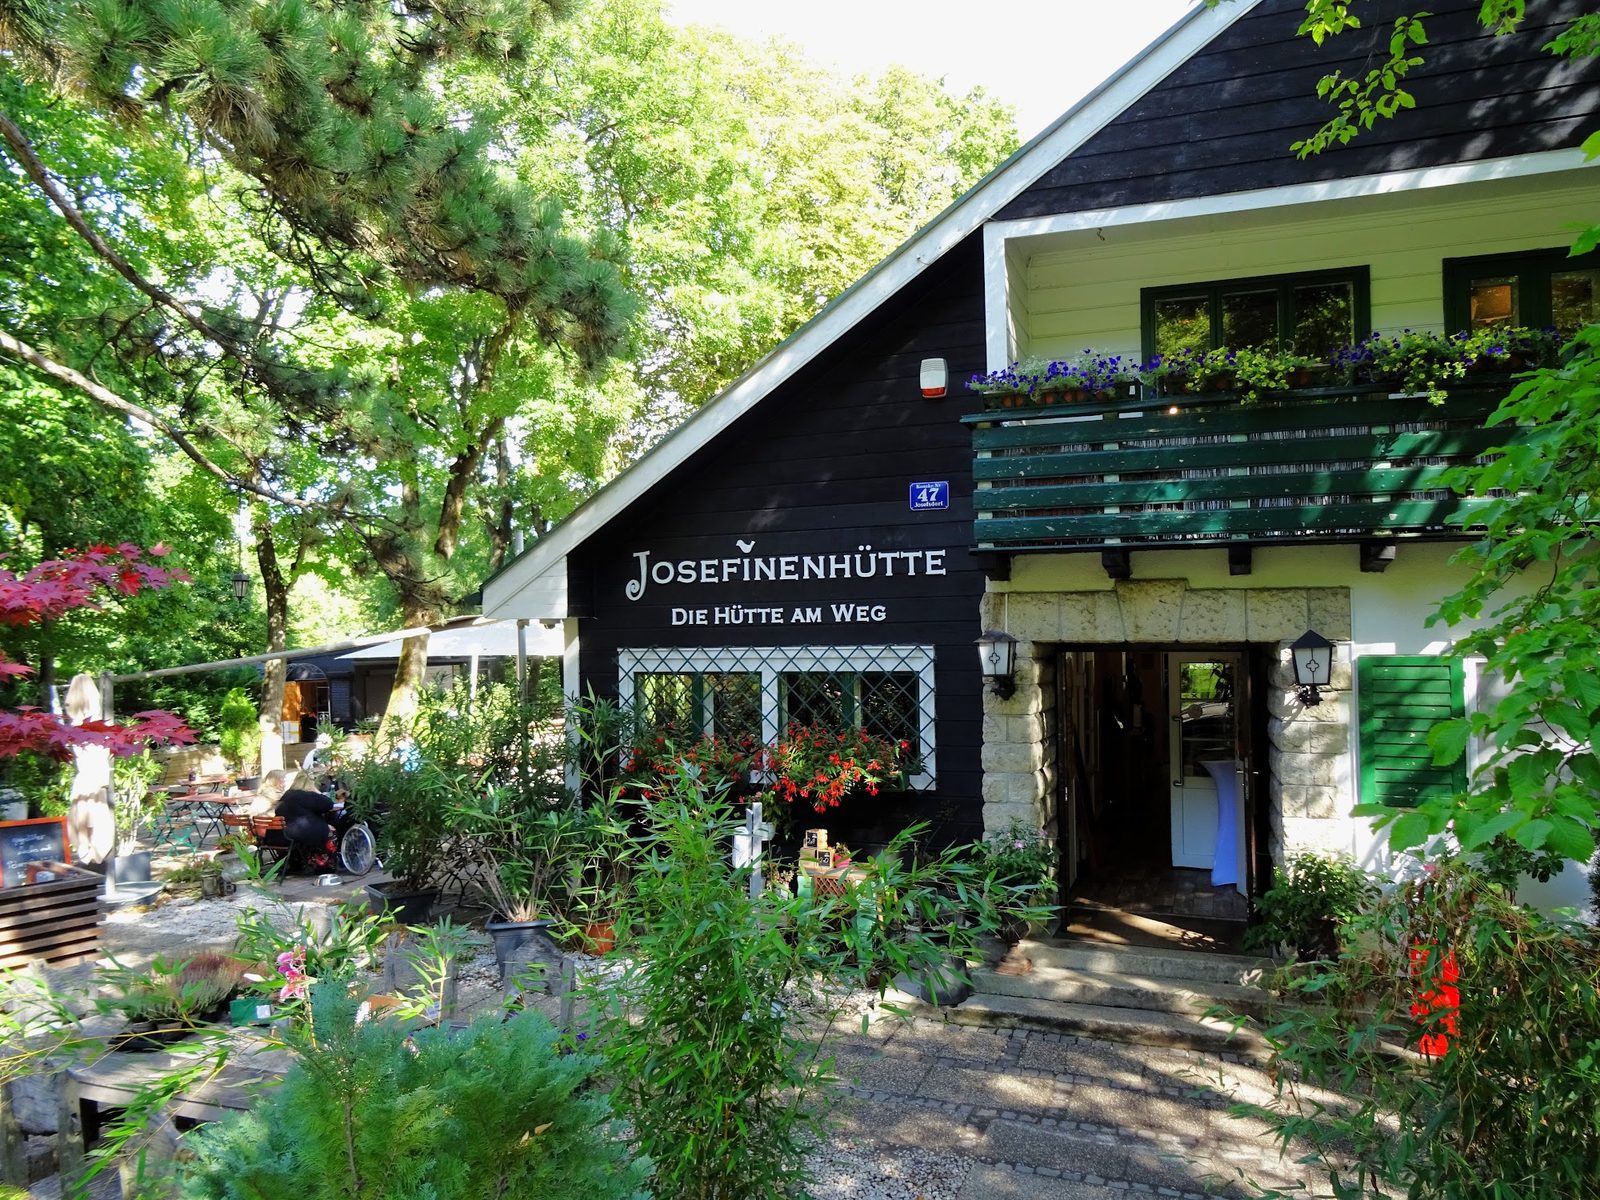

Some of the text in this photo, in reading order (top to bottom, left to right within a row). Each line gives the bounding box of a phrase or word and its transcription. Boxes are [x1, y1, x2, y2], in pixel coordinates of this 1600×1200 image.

[917, 488, 939, 502] 47
[671, 603, 887, 625] DIE HÜTTE AM WEG
